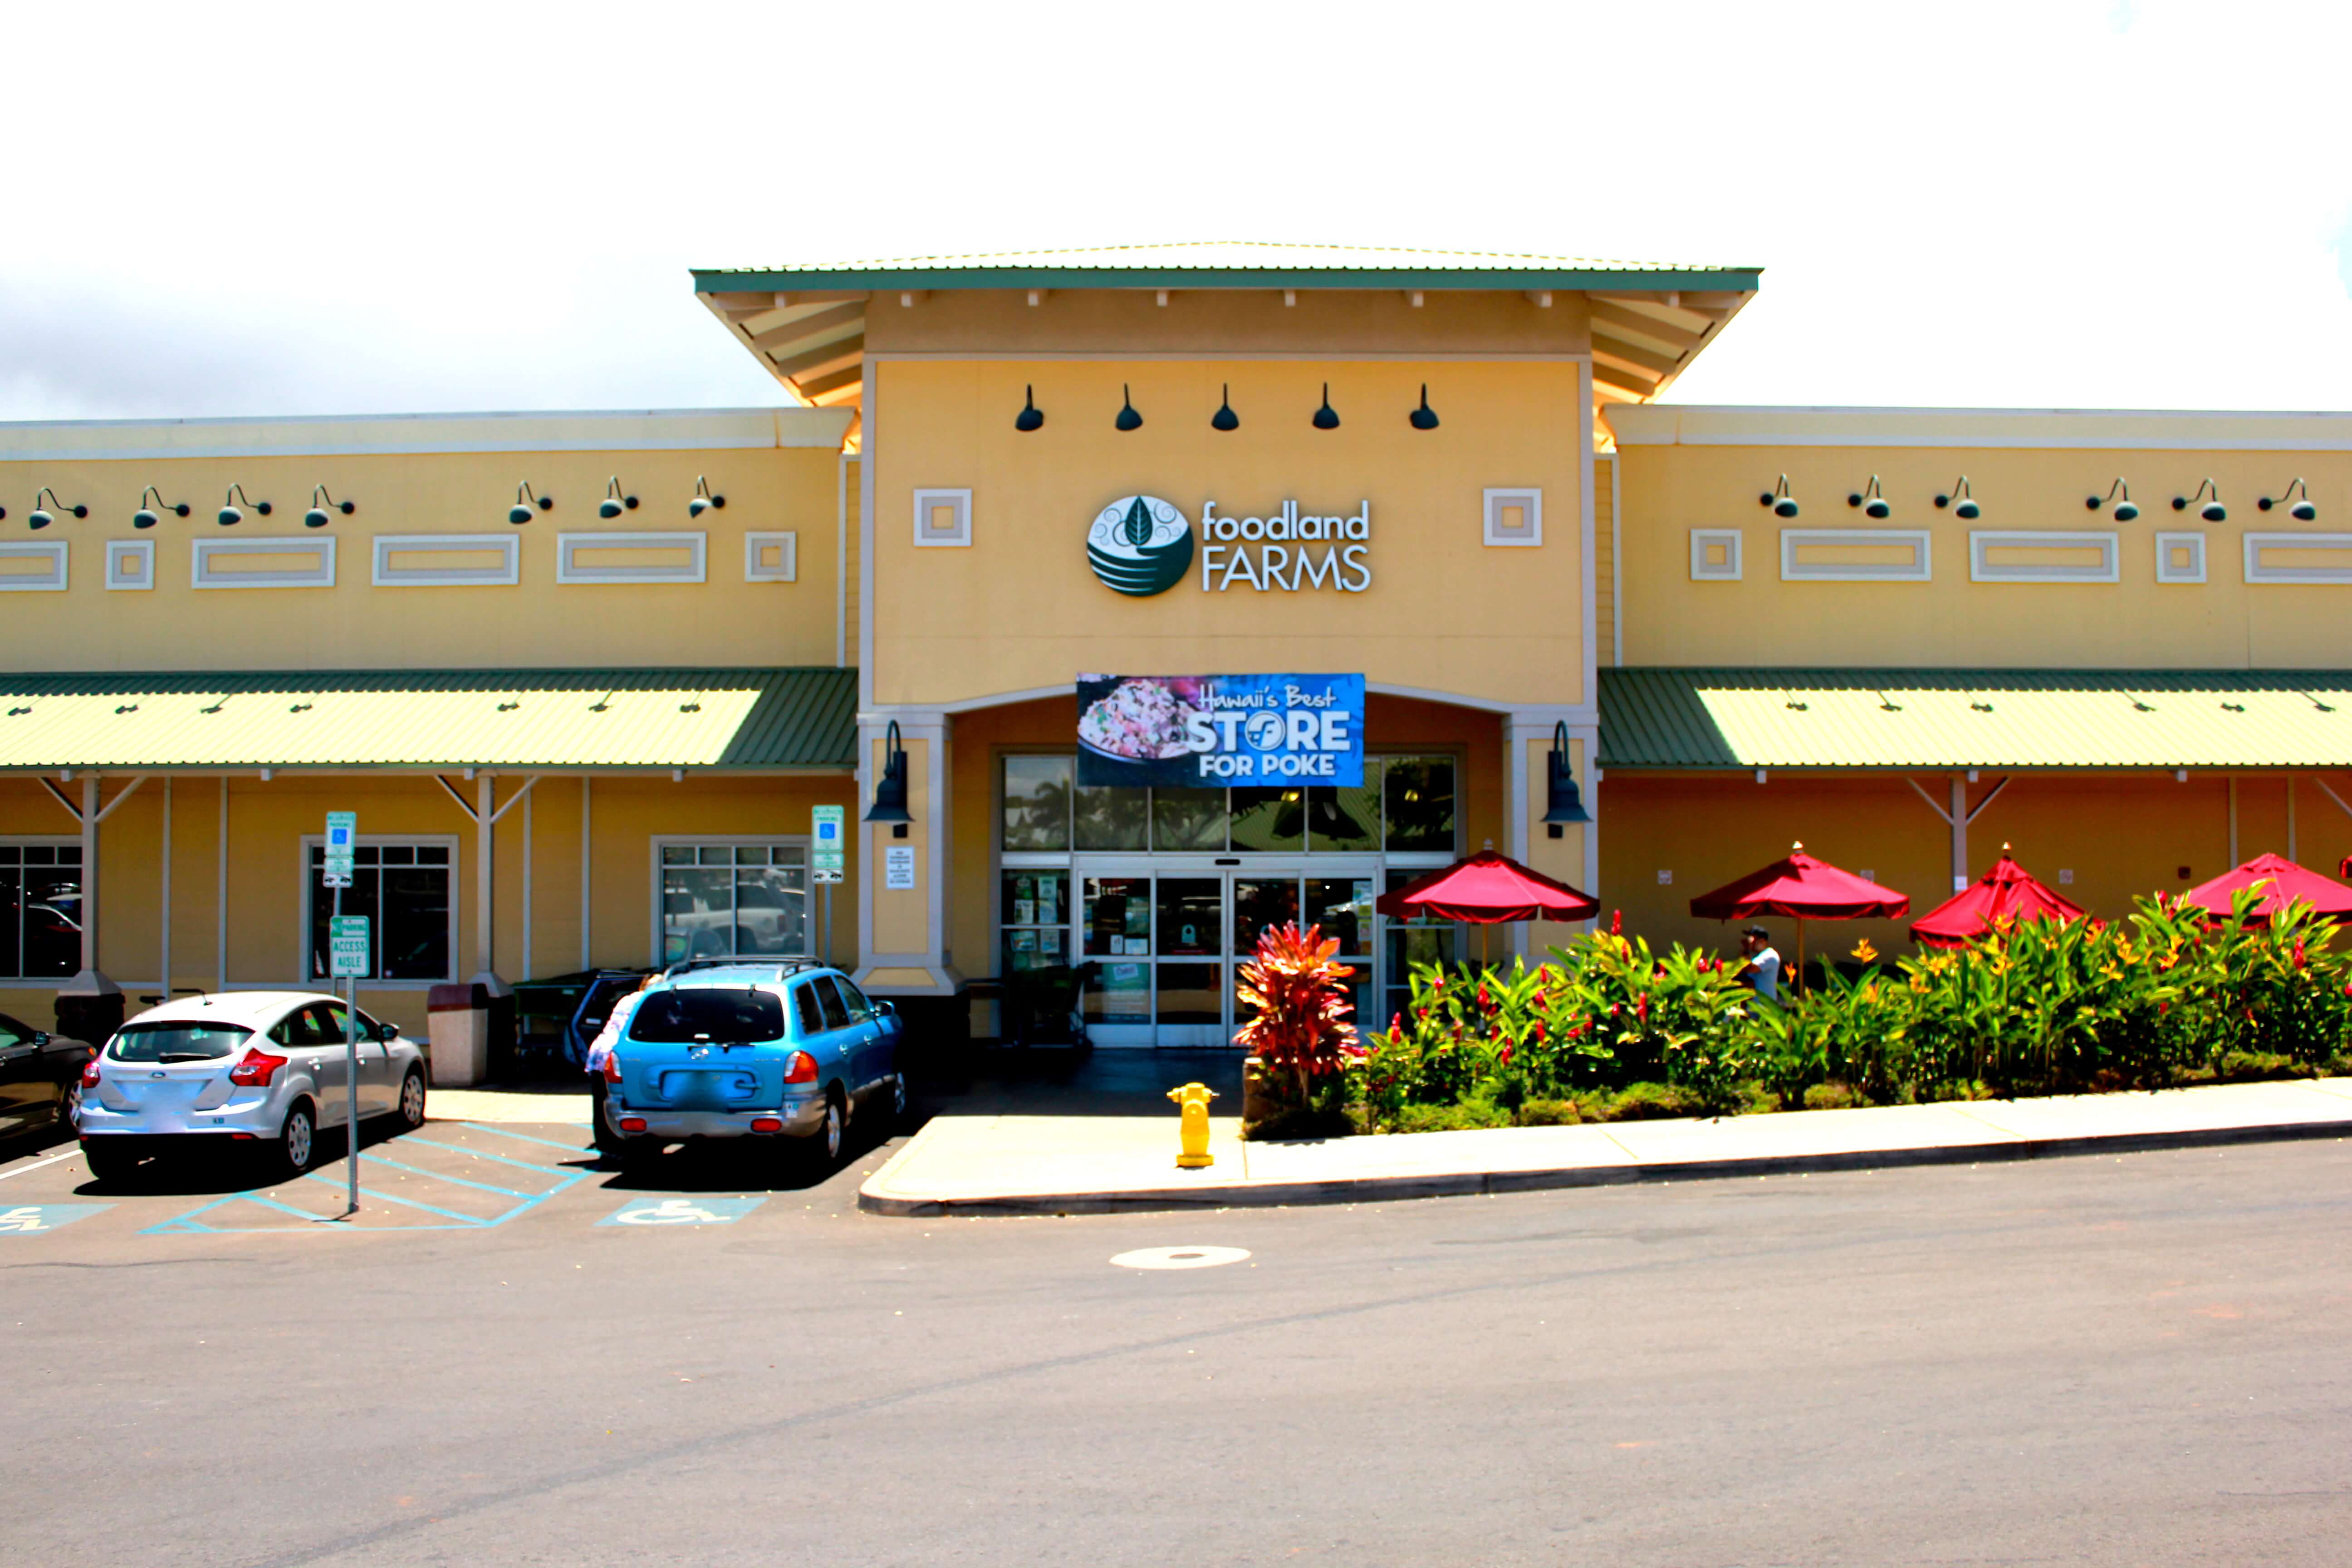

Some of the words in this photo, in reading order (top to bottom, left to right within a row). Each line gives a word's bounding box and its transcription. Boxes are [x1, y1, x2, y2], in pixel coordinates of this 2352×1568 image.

[1202, 500, 1369, 541] foodland
[1202, 544, 1371, 592] FARMS
[1198, 684, 1279, 710] Hawaii's
[1284, 684, 1337, 707] Best
[1186, 710, 1351, 752] STORE
[1200, 755, 1254, 777] FOR
[1262, 754, 1336, 776] POKE
[333, 941, 365, 952] ACCESS
[338, 956, 361, 967] AISLE
